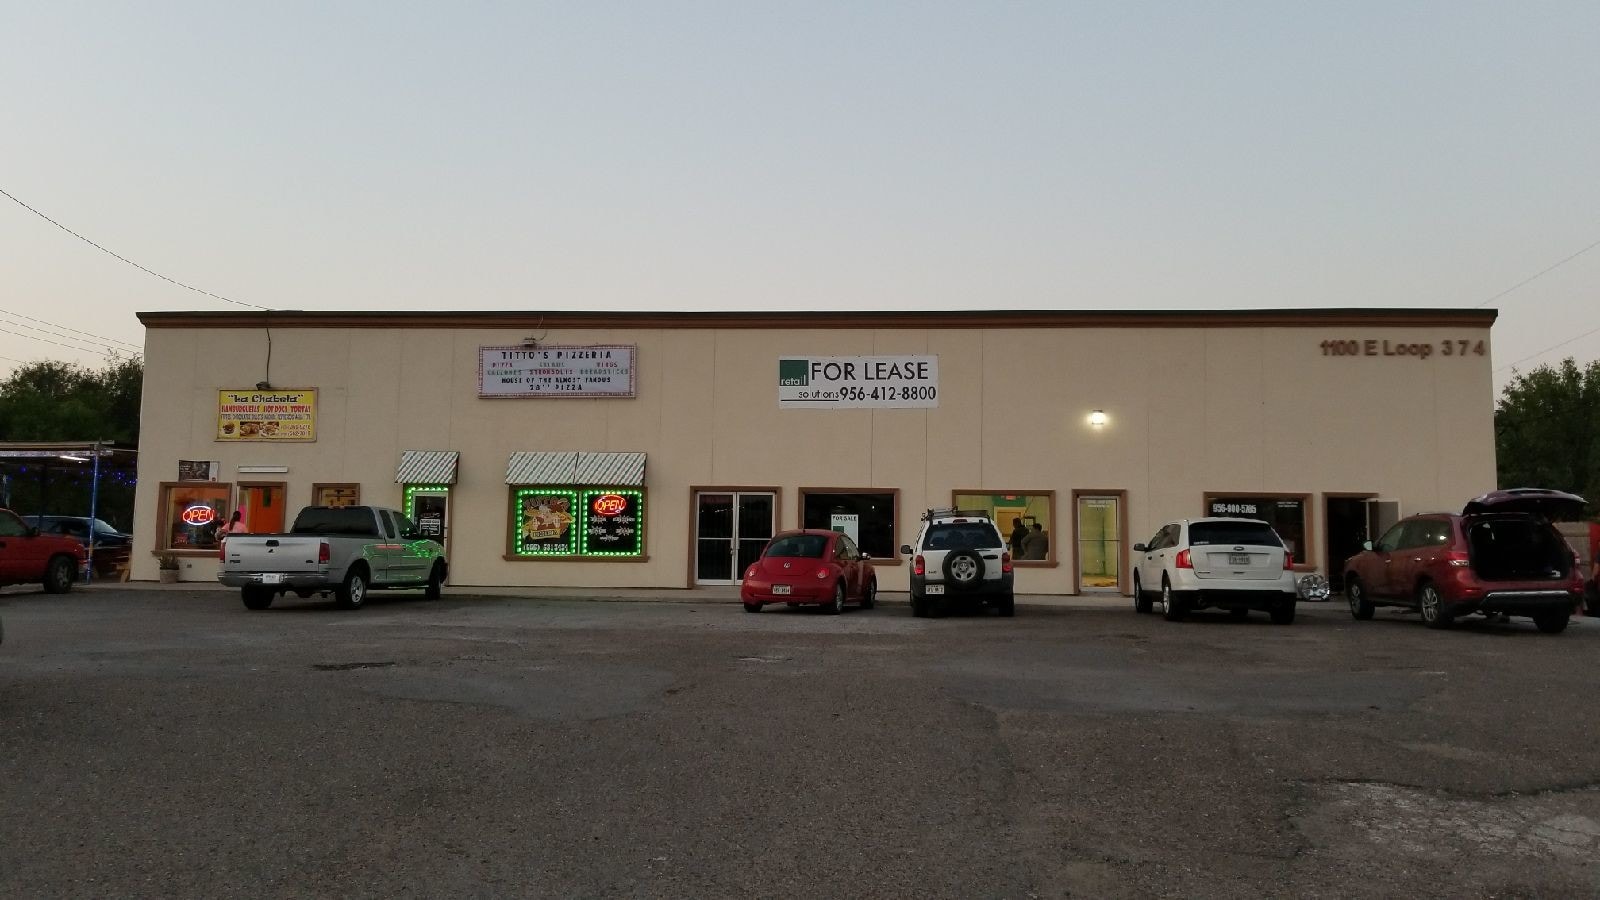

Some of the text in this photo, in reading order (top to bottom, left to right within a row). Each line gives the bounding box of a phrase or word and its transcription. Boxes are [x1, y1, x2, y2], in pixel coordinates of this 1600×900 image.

[502, 351, 612, 360] TITTO'S PIZZERIA
[1320, 339, 1486, 360] 1100 E Loop 374
[811, 361, 929, 381] FOR LEASE
[780, 374, 807, 386] retail
[798, 389, 840, 399] solutions
[839, 386, 937, 401] 956-412-8800
[594, 499, 624, 511] OPEN
[182, 509, 215, 522] OPEN
